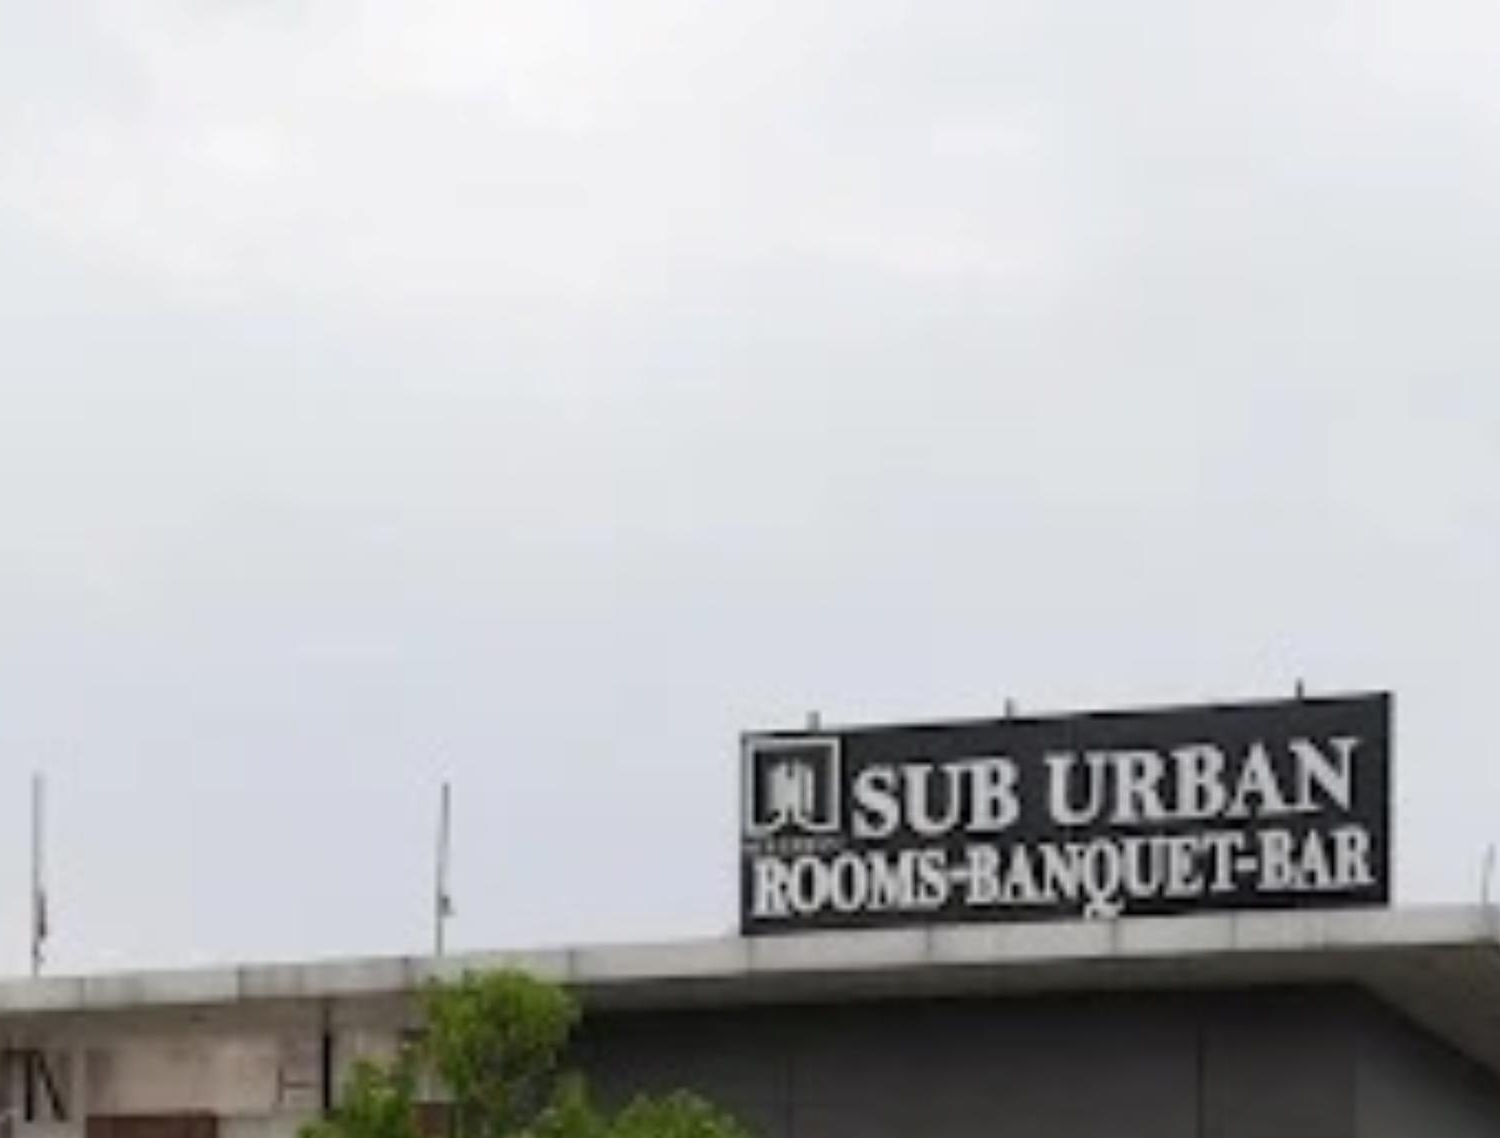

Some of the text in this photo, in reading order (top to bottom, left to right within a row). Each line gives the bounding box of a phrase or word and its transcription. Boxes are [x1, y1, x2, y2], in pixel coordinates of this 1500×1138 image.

[852, 757, 1019, 839] SUB
[1045, 737, 1359, 824] URBAN
[752, 826, 1375, 920] ROOMS-BANQUET-BAR
